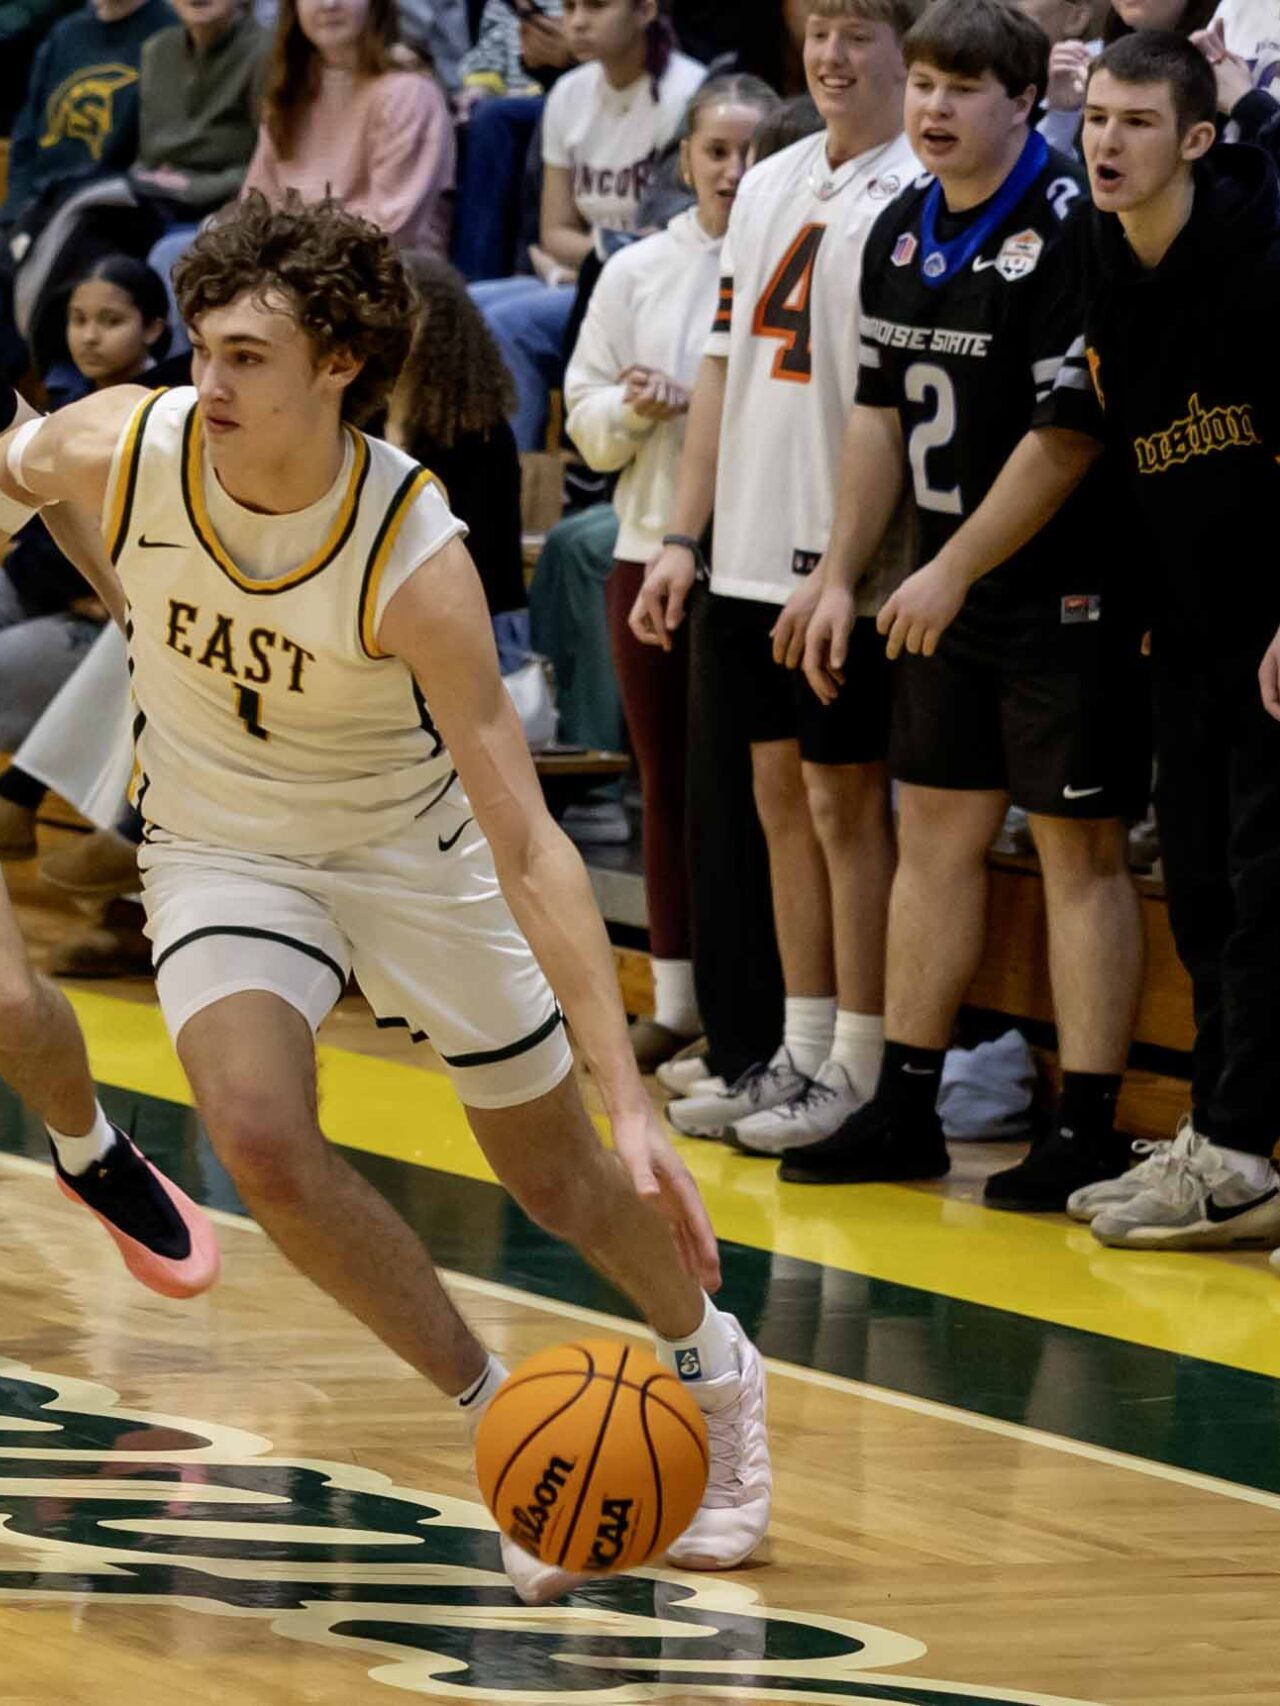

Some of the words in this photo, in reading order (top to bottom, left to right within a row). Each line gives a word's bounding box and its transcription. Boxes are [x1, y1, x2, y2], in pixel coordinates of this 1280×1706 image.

[751, 221, 827, 385] 4
[930, 328, 993, 357] STATE
[904, 361, 964, 515] 2
[166, 598, 316, 694] EAST
[232, 680, 270, 742] 1
